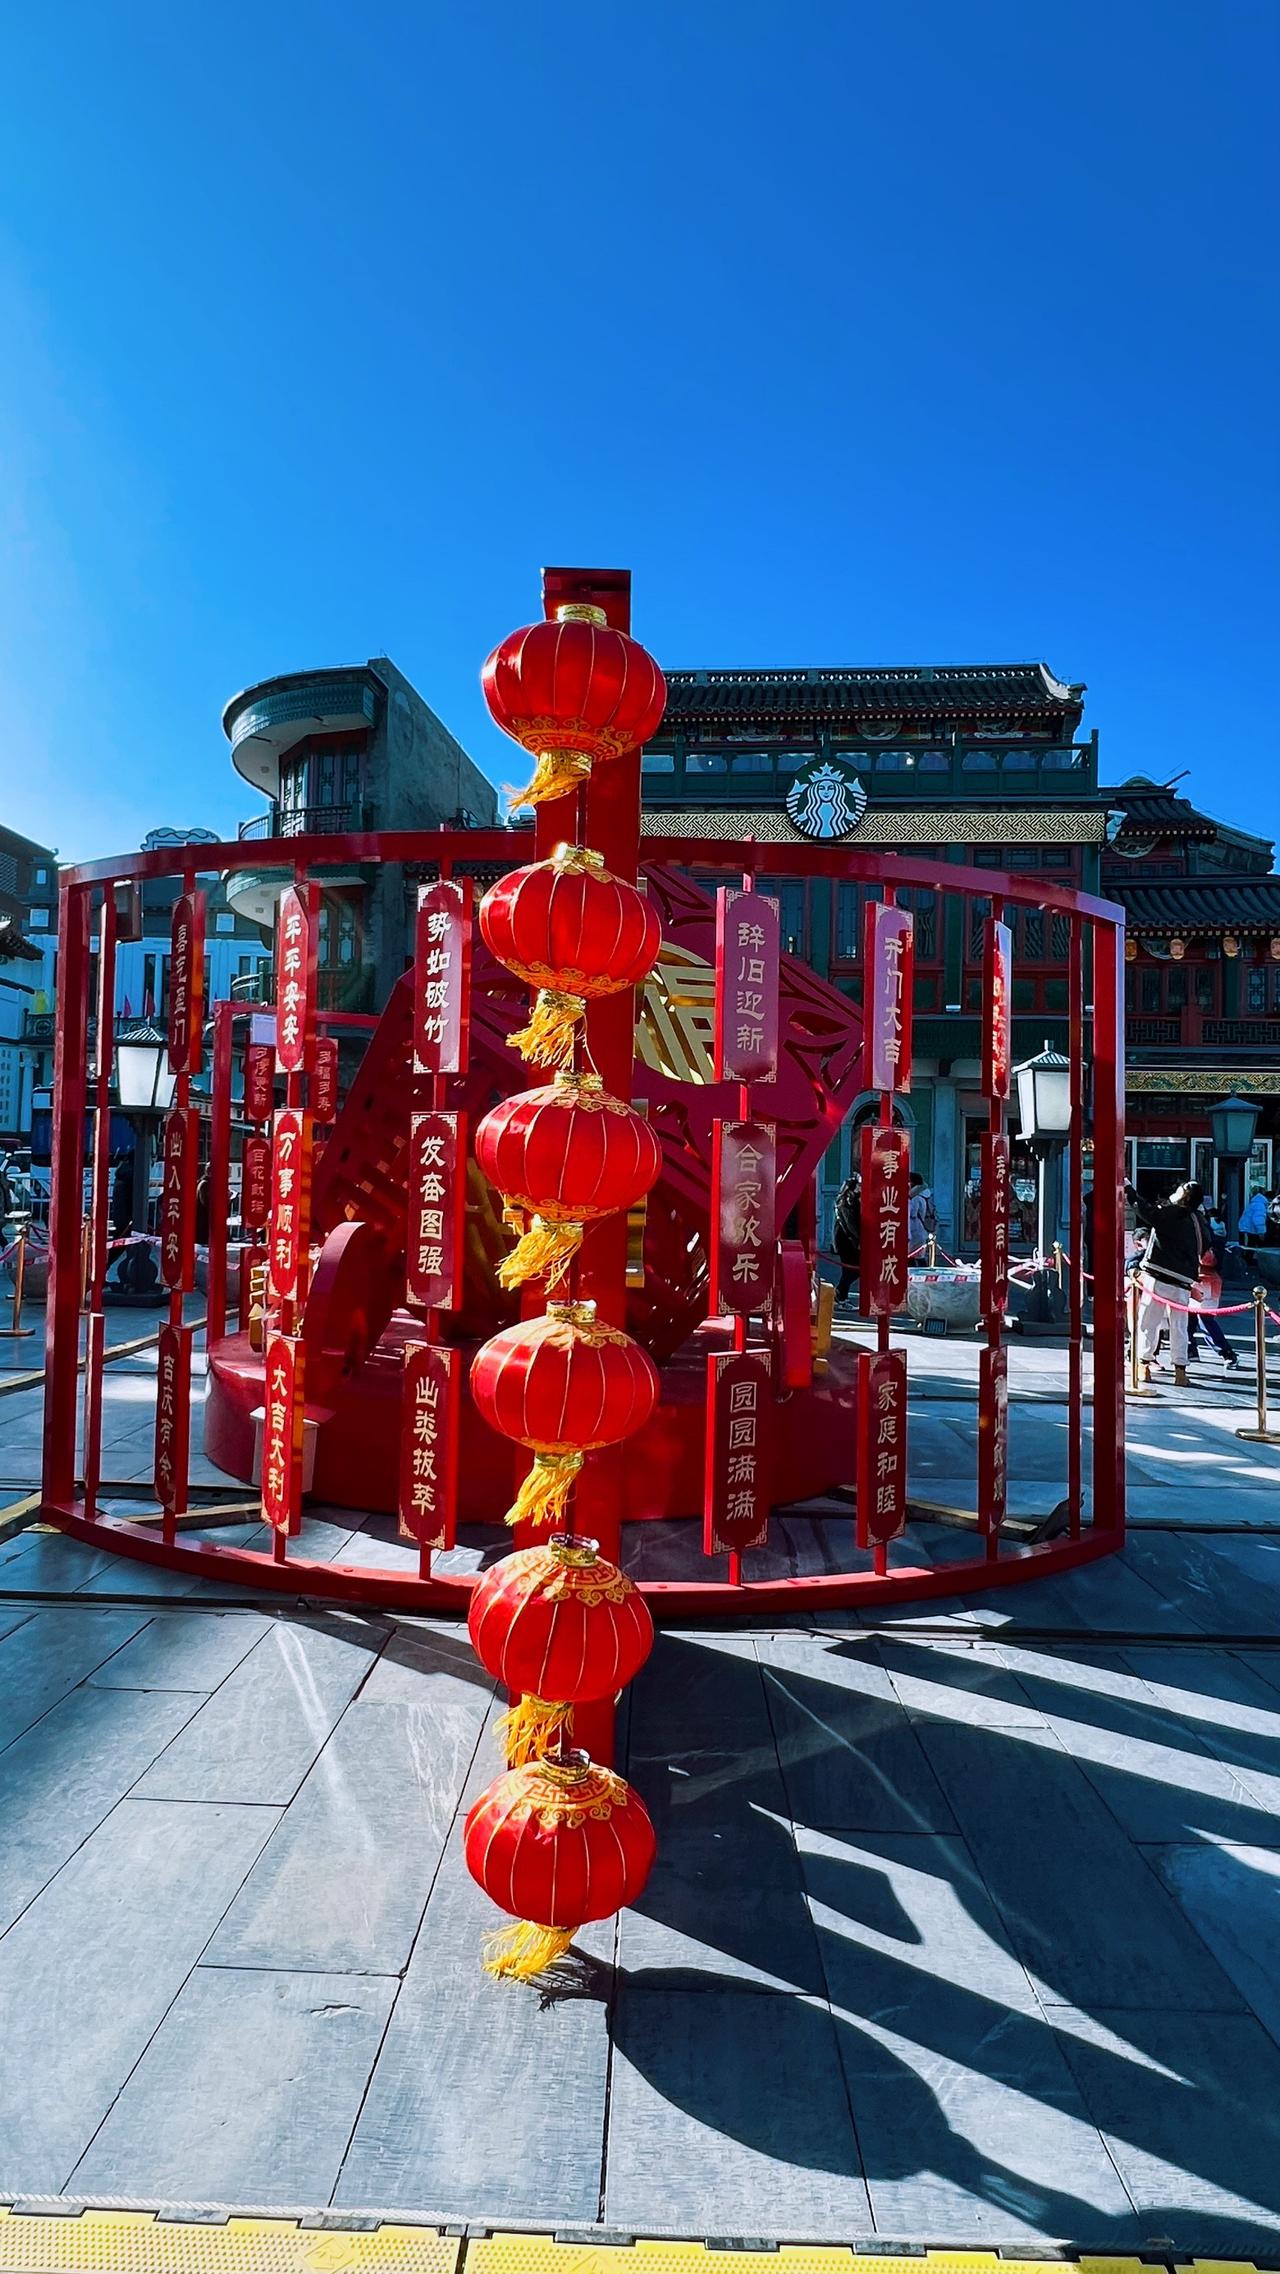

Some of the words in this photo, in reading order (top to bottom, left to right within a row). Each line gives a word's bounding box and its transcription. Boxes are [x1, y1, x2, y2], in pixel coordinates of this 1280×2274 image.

[173, 924, 188, 1046] 喜气盈门
[282, 914, 302, 1046] 平平安安
[424, 911, 452, 1044] 势如破竹
[736, 922, 766, 1054] 辞旧迎新
[883, 936, 904, 1065] 开门大吉
[166, 1131, 182, 1263] 出入平安
[276, 1131, 297, 1270] 万事顺利
[418, 1135, 447, 1276] 发奋图强
[732, 1143, 764, 1284] 合家欢乐
[879, 1150, 901, 1285] 事业有成
[995, 1155, 1006, 1284] 寿比南山
[159, 1352, 175, 1481] 吉庆有余
[268, 1364, 288, 1503] 大吉大利
[411, 1376, 439, 1516] 出类拔萃
[726, 1381, 757, 1521] 圆圆满满
[877, 1380, 898, 1514] 家庭和睦
